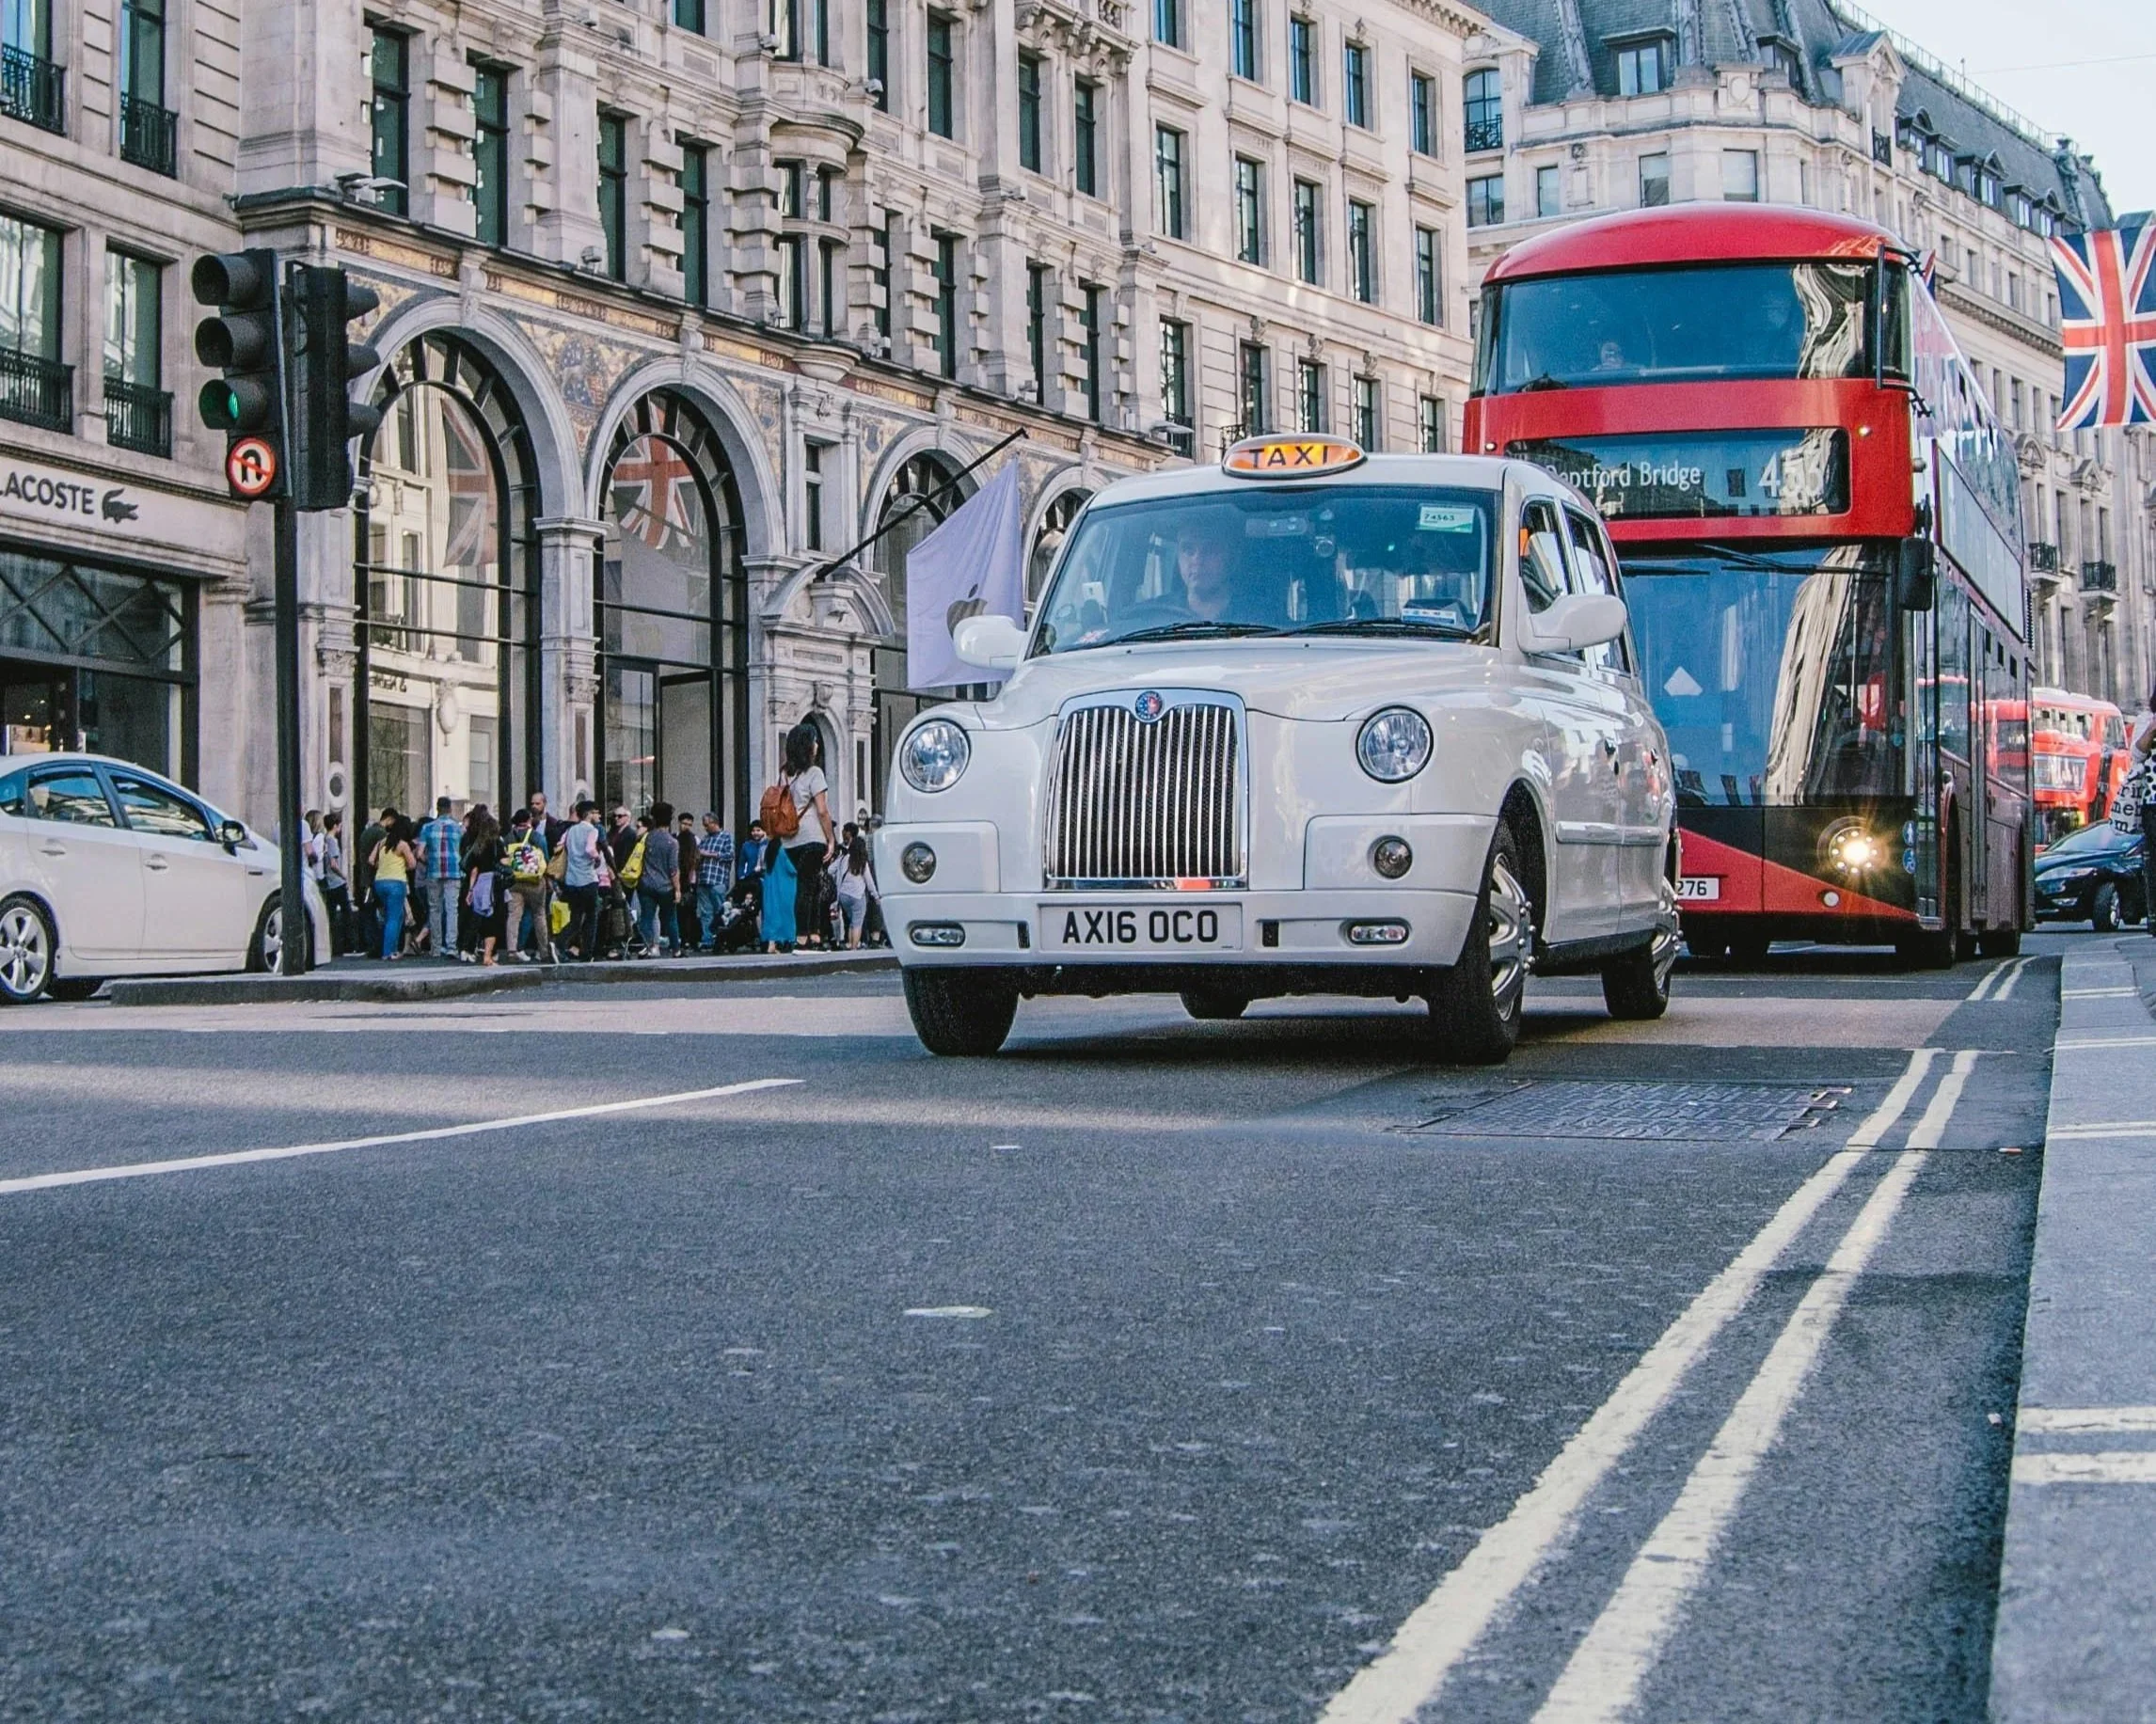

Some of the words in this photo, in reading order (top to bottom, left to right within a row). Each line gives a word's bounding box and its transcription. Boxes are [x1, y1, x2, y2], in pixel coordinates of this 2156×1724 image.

[1249, 445, 1328, 468] TAXI
[1640, 460, 1701, 492] Bridge
[0, 472, 94, 514] ACOSTE
[1062, 910, 1137, 944] AX16
[1149, 909, 1218, 943] OCO
